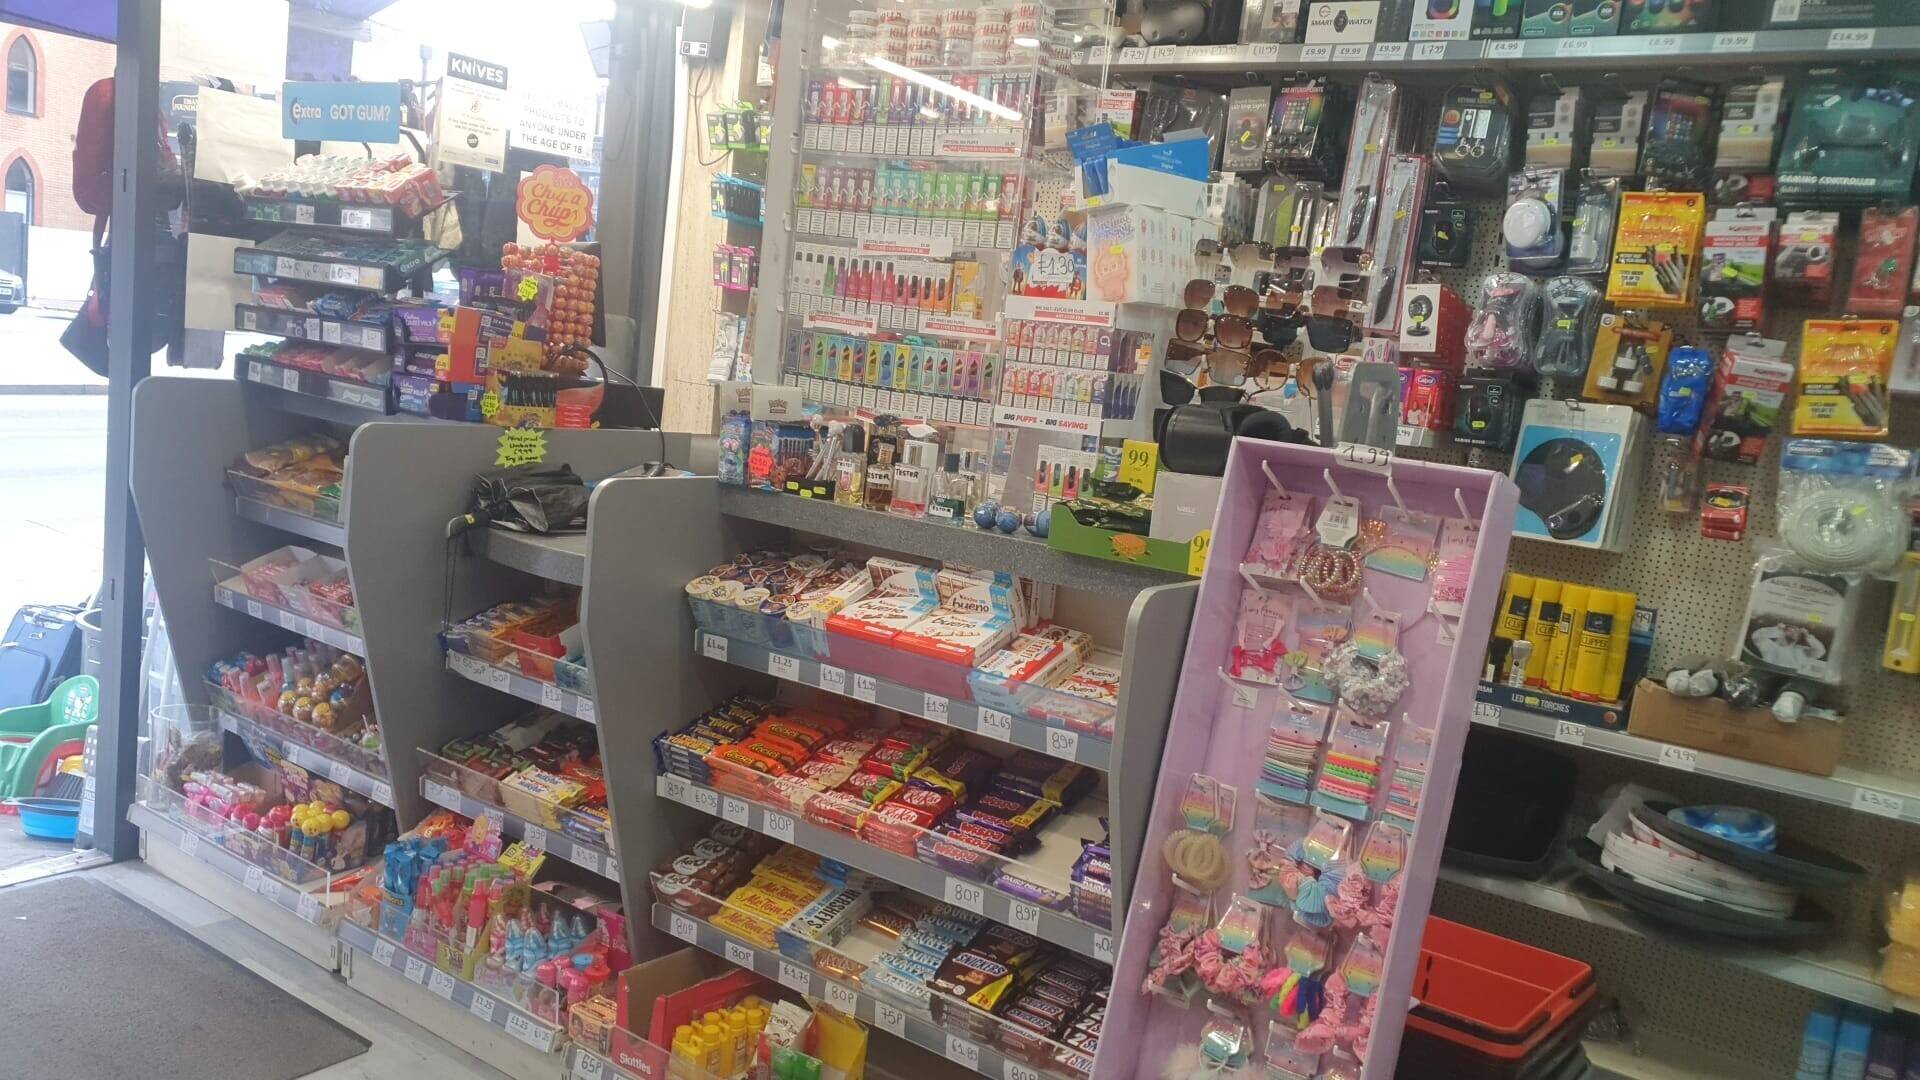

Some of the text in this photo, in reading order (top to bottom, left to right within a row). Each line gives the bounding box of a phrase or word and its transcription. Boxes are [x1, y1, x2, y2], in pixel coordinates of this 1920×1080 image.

[1311, 17, 1373, 27] SMART WATCH
[451, 57, 505, 83] KNIVES
[292, 101, 391, 122] extra GOT GUM?
[519, 119, 587, 142] ANYONE UNDER
[521, 133, 583, 154] THE AGE OF 18
[1038, 253, 1075, 276] £1.30
[1015, 415, 1038, 424] PUFFS
[1058, 419, 1089, 430] SAVINGS
[1342, 445, 1391, 467] 1.99
[895, 468, 919, 479] TESTER
[953, 597, 989, 613] bueno
[932, 616, 976, 629] bueno
[773, 654, 793, 668] £1.25
[1511, 694, 1570, 713] LED TORCHES
[769, 815, 792, 830] 80P
[1002, 874, 1025, 887] DAIRY
[954, 883, 981, 903] 80P
[807, 888, 863, 929] HERSHEY'S
[675, 918, 694, 935] 80P
[731, 946, 752, 962] 80P
[959, 953, 1008, 975] SNICKERS
[831, 984, 854, 1004] 80P
[581, 1055, 602, 1074] 65P
[619, 1052, 651, 1075] Skittles
